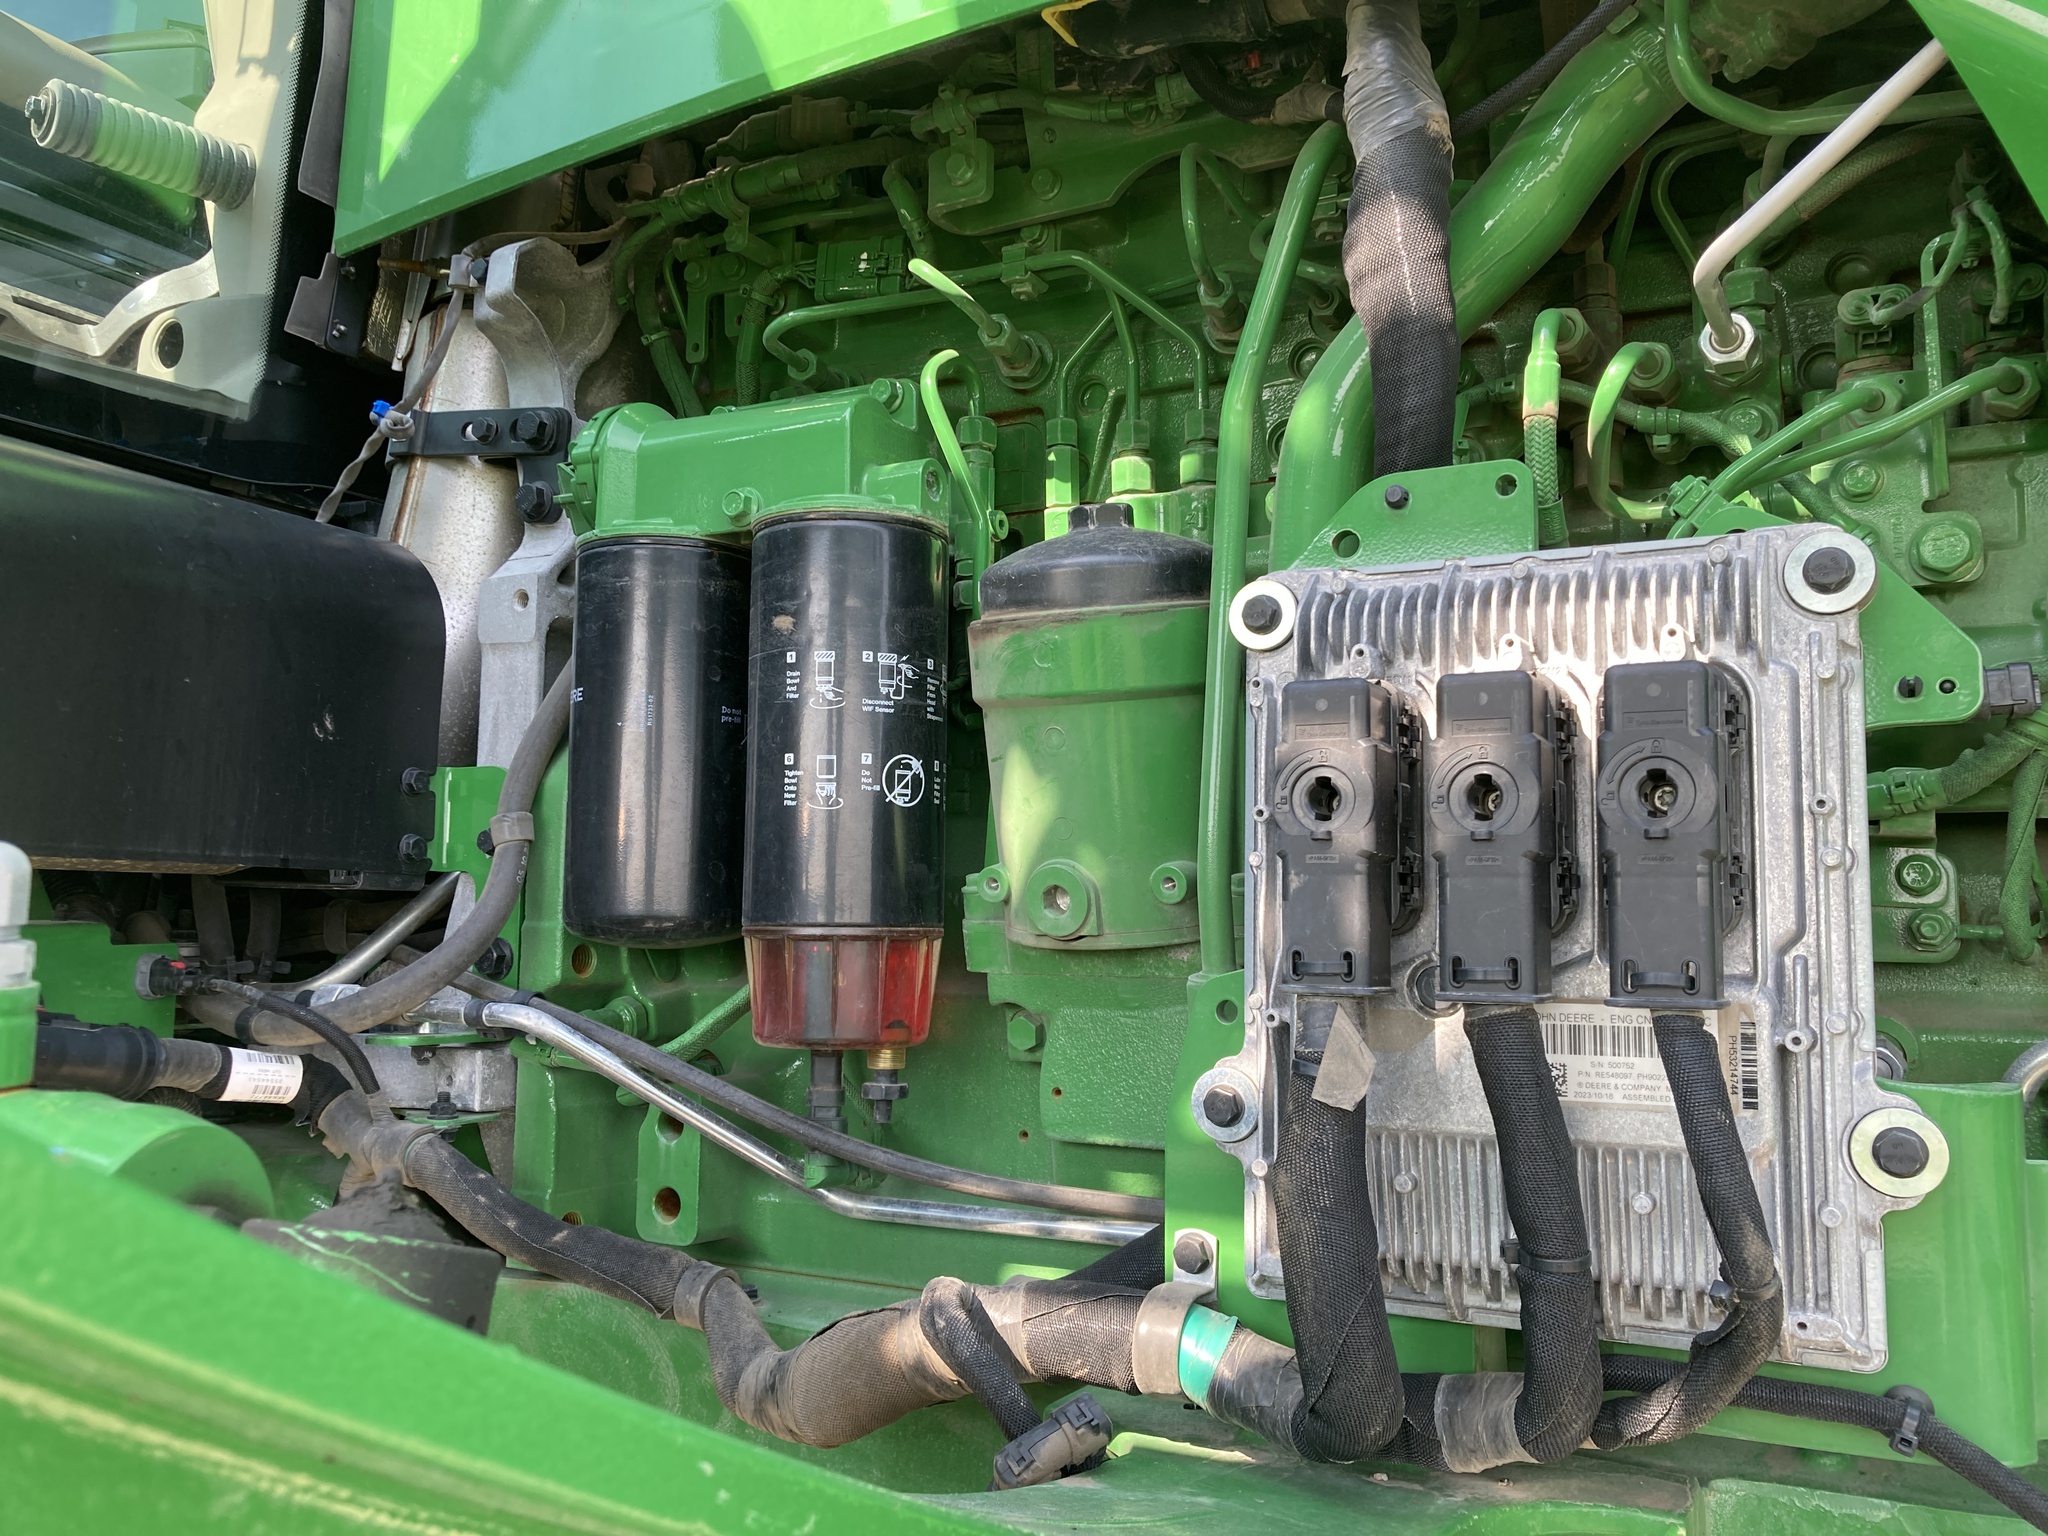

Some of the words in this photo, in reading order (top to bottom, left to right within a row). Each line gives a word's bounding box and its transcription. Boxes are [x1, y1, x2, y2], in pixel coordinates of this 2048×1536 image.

[862, 698, 894, 706] Disconnect
[784, 769, 804, 777] Tighten
[1537, 1012, 1556, 1022] OHN
[1559, 1012, 1595, 1023] DEERE
[1610, 1014, 1633, 1025] ENG
[1607, 1061, 1635, 1070] 500752
[1728, 1035, 1739, 1096] PH53214744
[1637, 1073, 1669, 1082] PH9022
[1585, 1081, 1612, 1090] DEERE
[1613, 1083, 1619, 1091] &
[1621, 1083, 1662, 1092] COMPANY
[1573, 1091, 1614, 1100] 2023/10/18
[1622, 1093, 1672, 1103] ASSEMBLED
